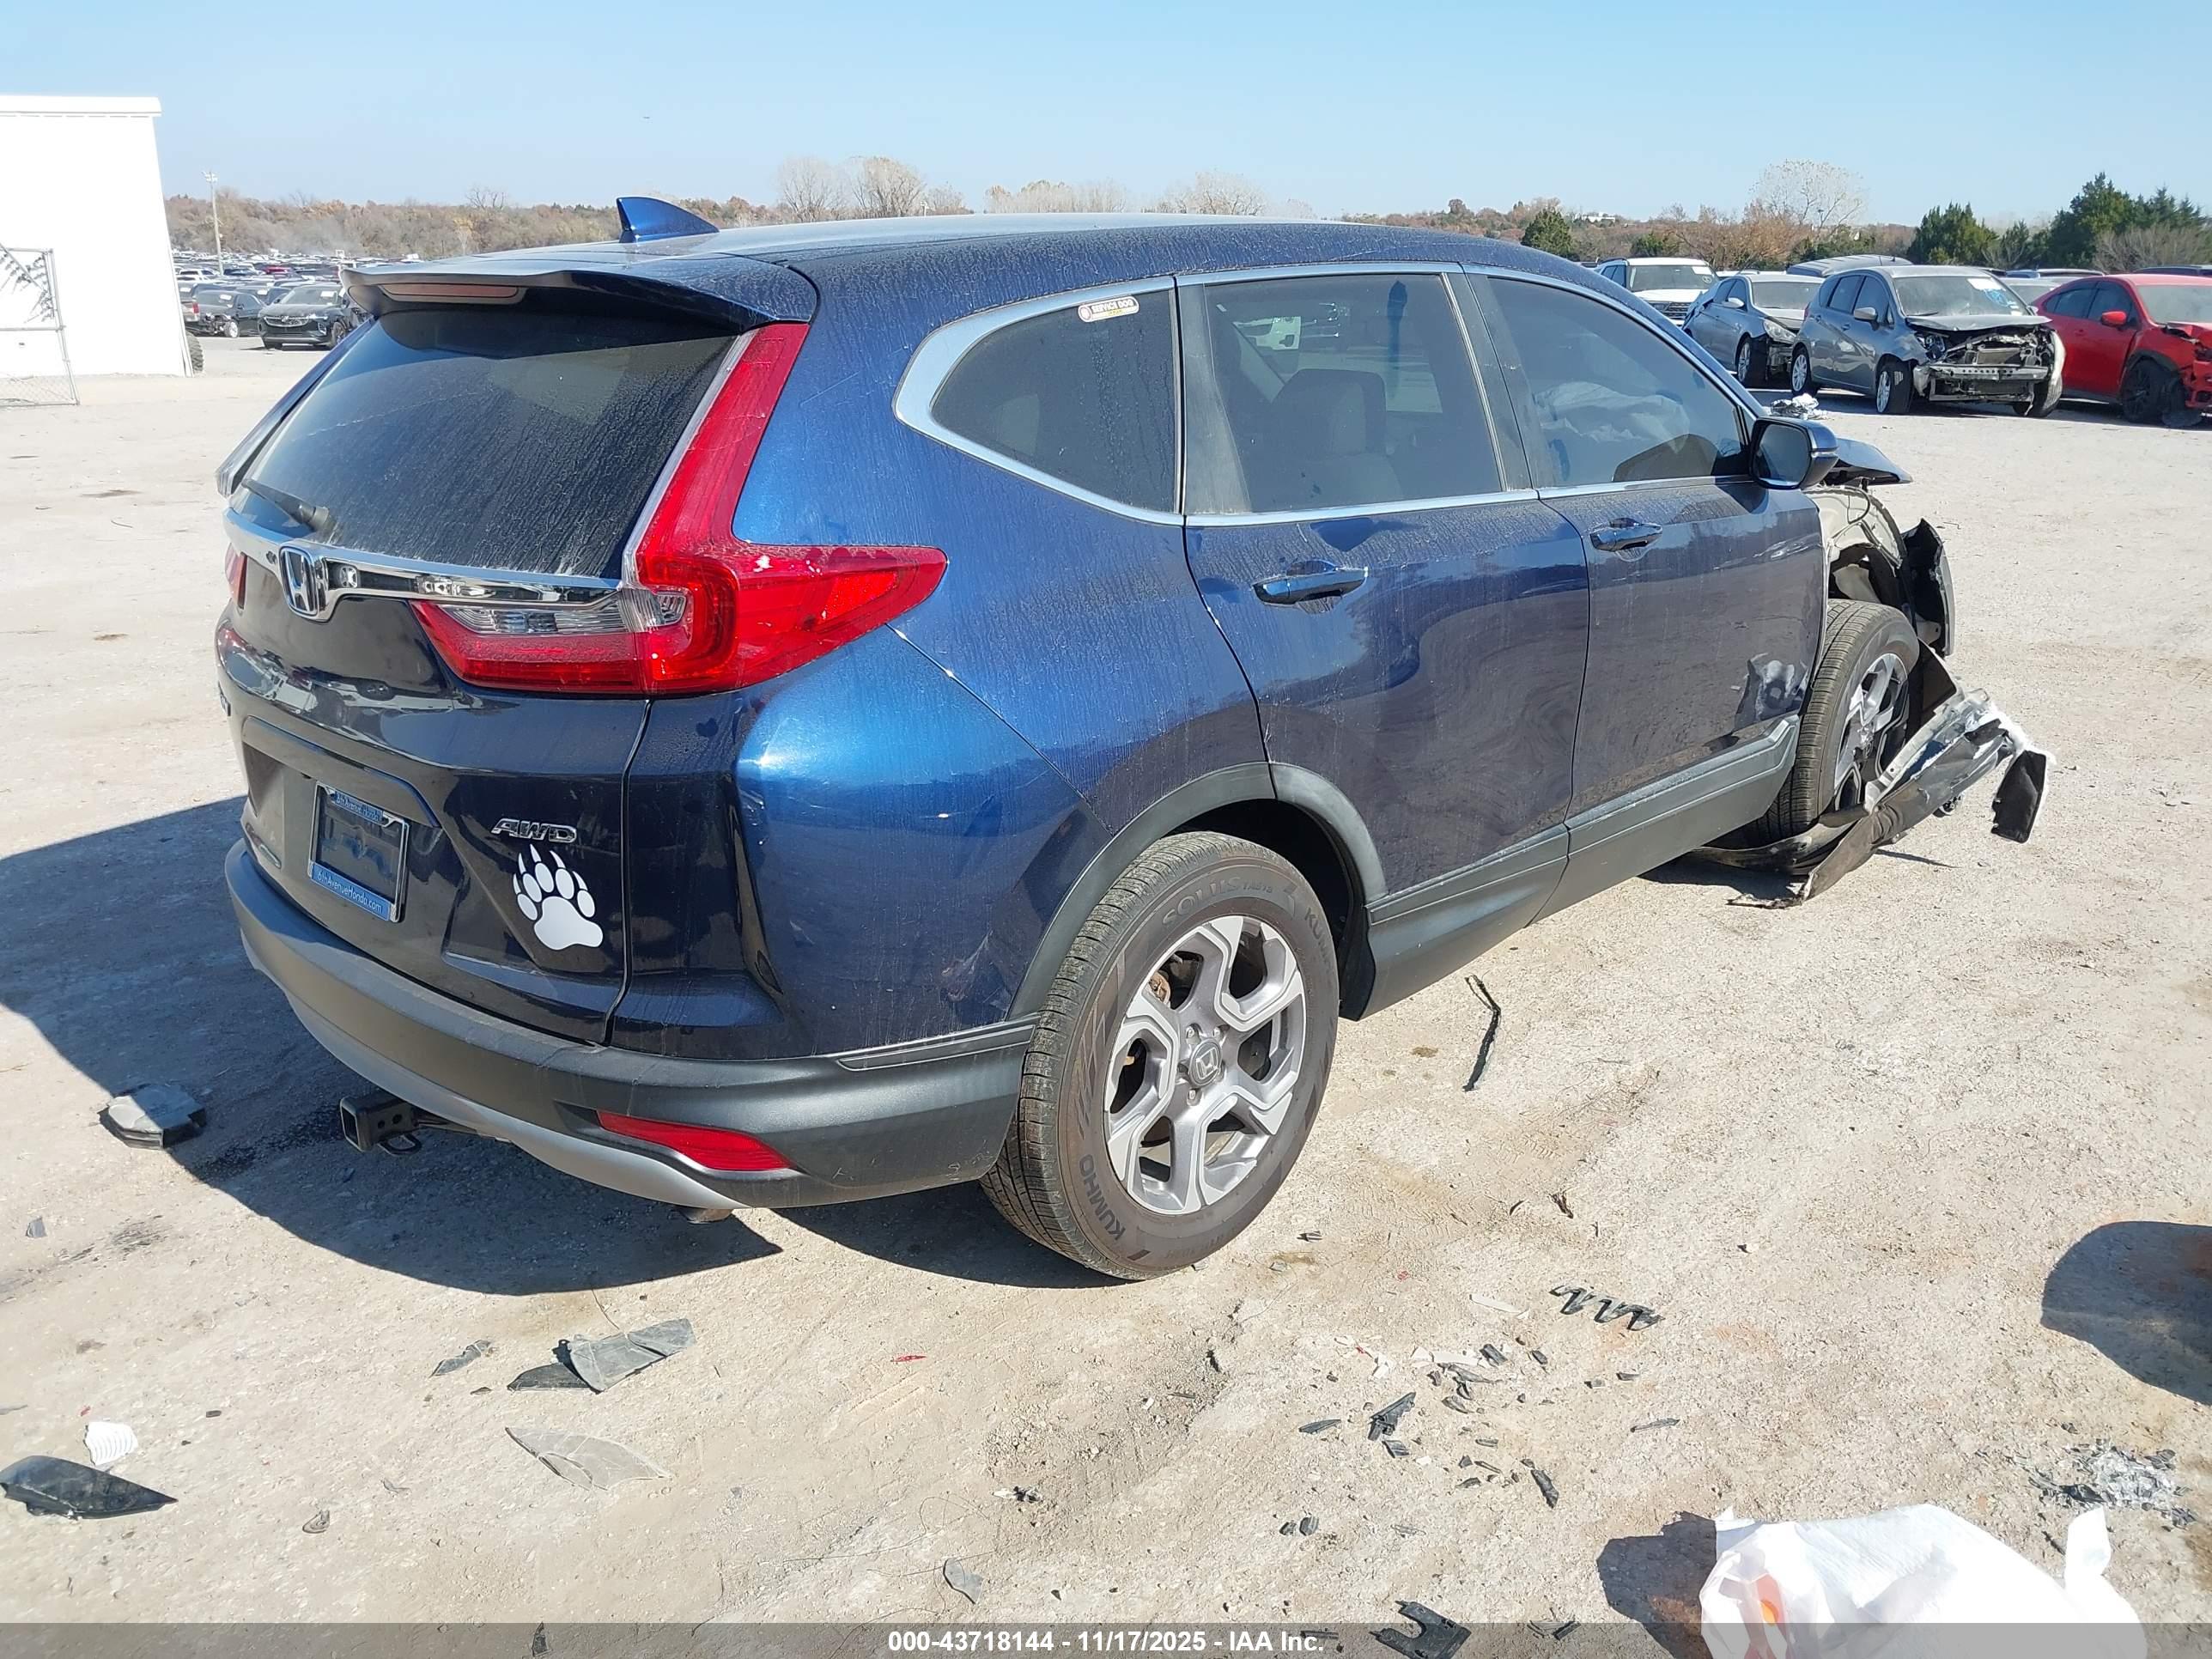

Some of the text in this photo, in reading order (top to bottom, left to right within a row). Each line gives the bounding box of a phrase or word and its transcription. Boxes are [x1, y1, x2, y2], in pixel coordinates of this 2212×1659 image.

[490, 818, 577, 842] AWD
[318, 871, 384, 915] 6thAvenueHonda.com
[1079, 1154, 1126, 1240] KUMHO
